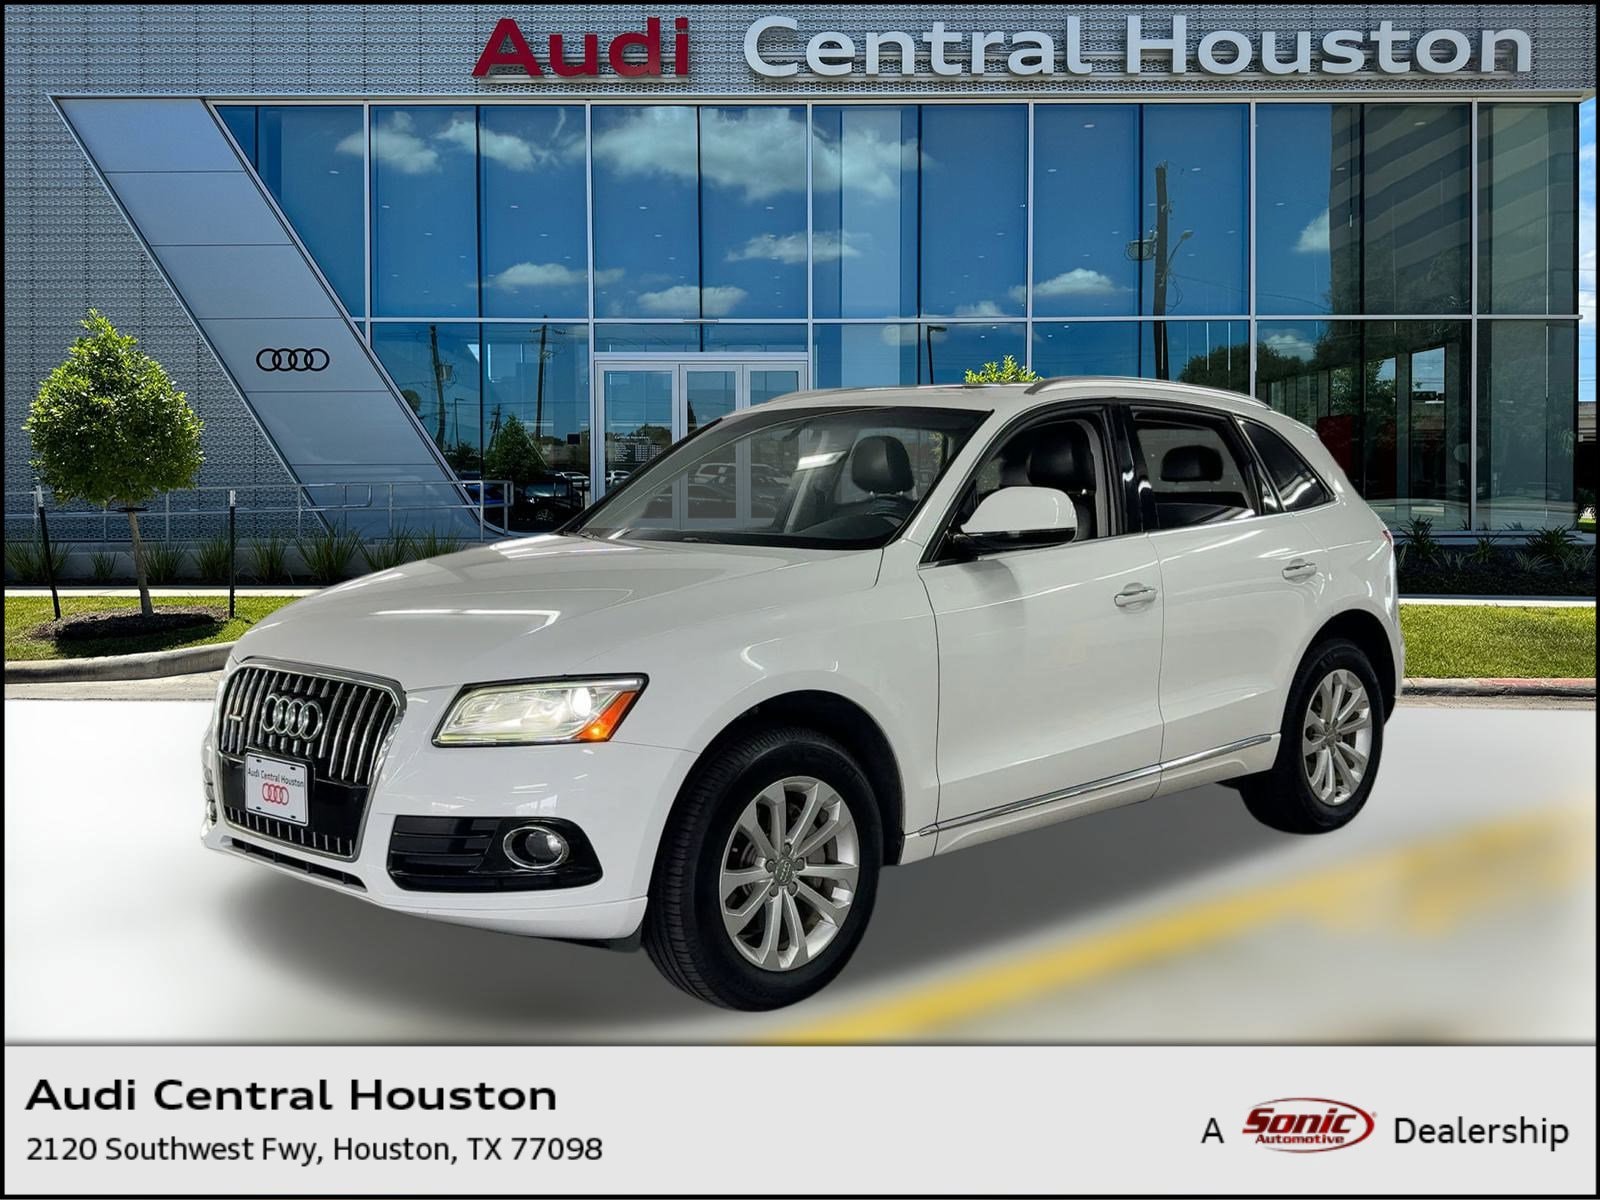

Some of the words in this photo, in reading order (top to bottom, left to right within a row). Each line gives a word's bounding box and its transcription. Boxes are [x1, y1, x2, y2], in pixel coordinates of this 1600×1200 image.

[471, 16, 690, 78] Audi
[743, 15, 1093, 77] Central
[1125, 14, 1532, 76] Houston
